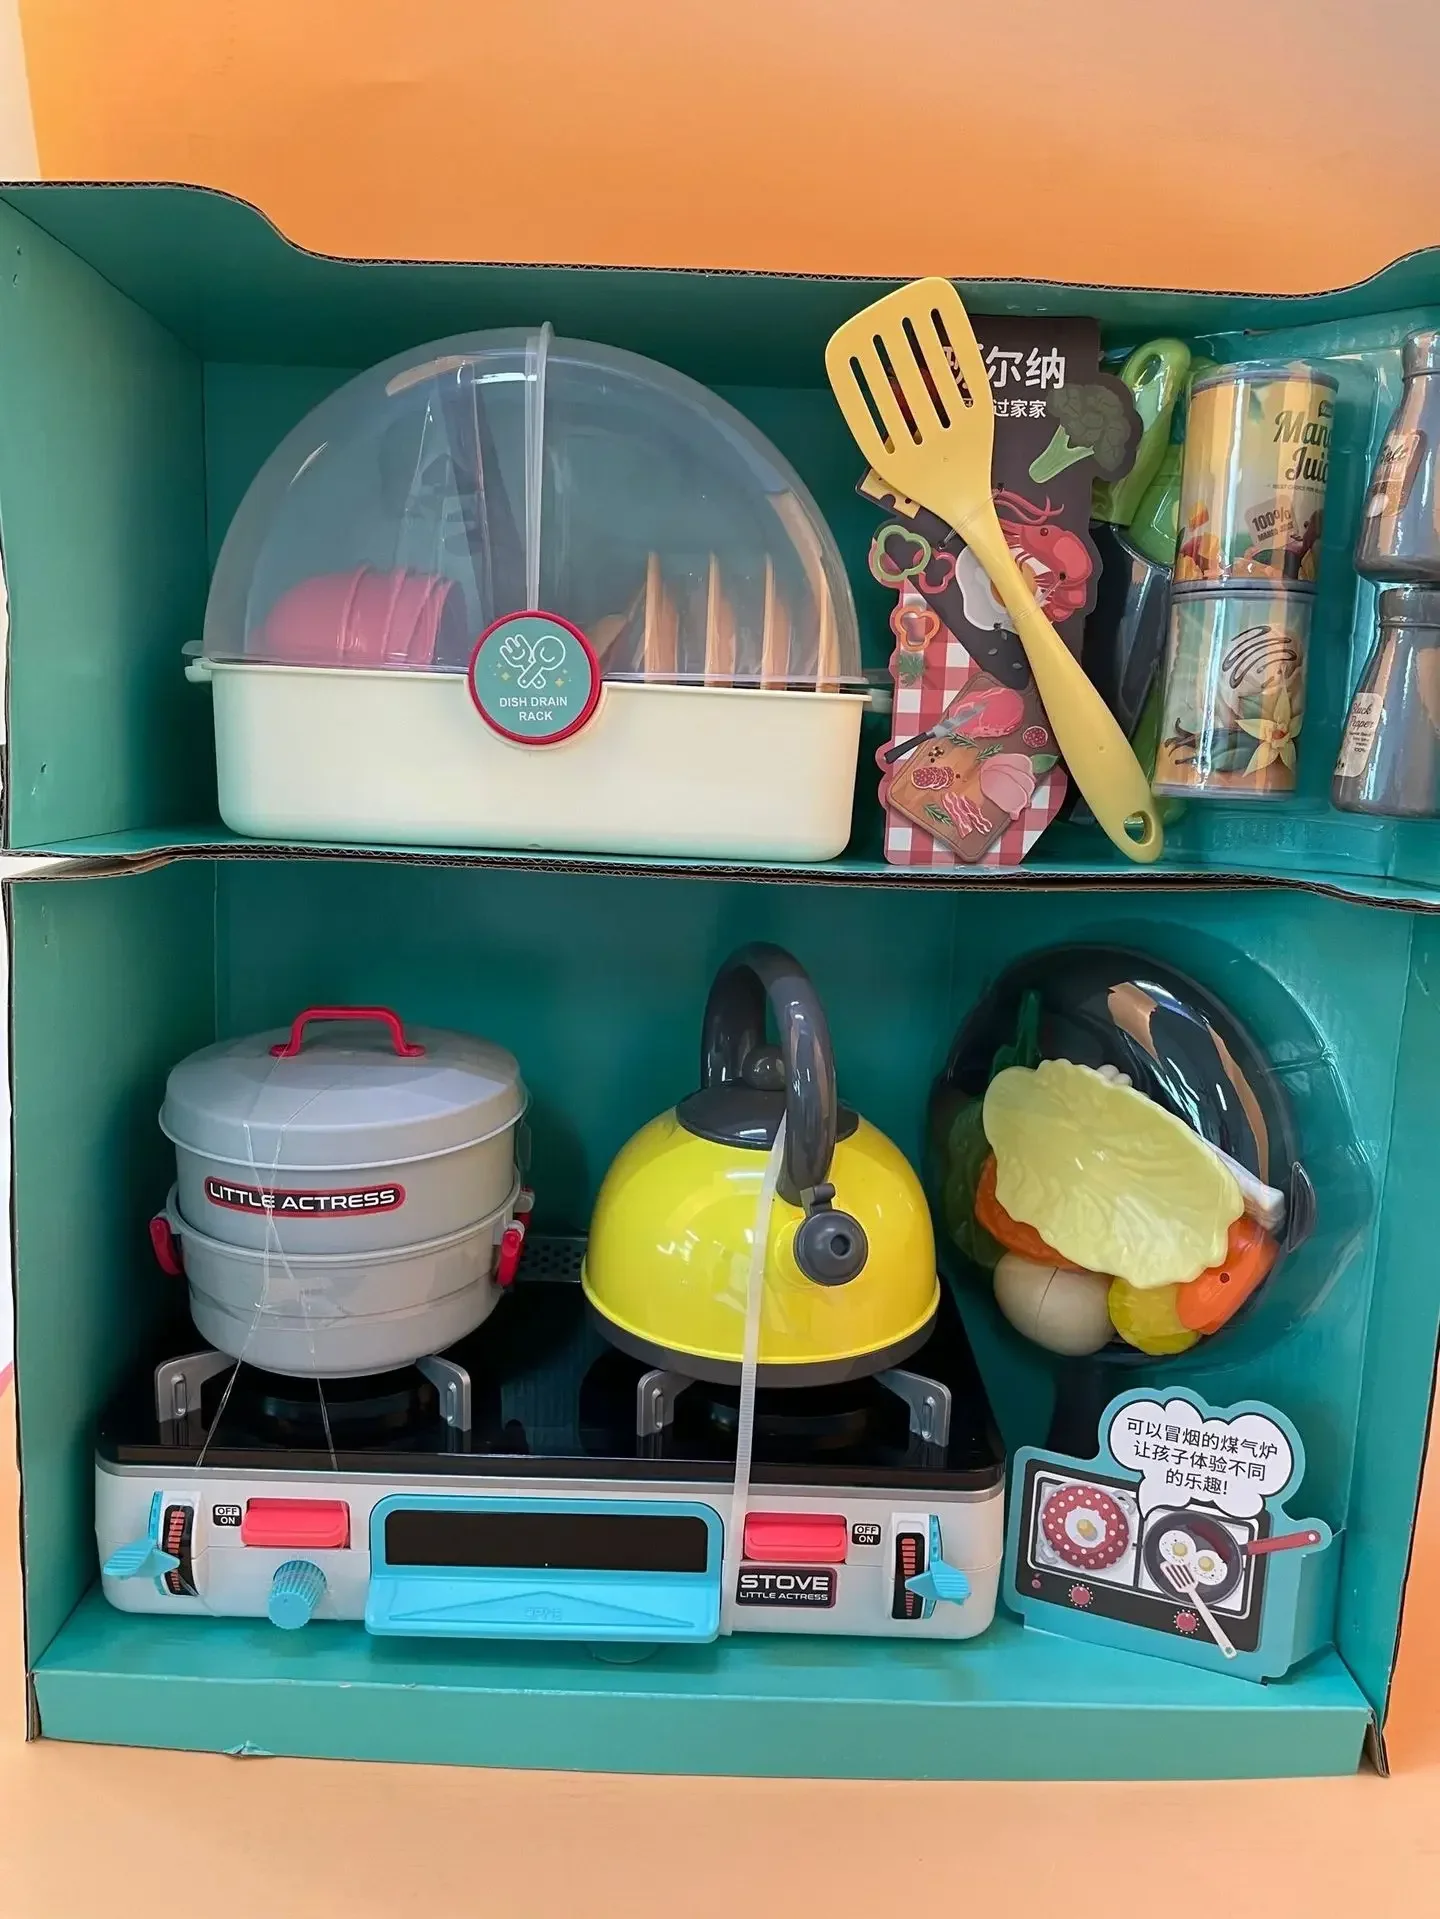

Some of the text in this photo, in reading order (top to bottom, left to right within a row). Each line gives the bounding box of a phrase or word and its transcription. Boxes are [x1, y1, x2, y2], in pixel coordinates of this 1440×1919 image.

[978, 344, 1066, 389] 尔纳
[1252, 506, 1292, 532] 100%
[500, 696, 568, 707] DISH DRAIN
[519, 711, 553, 721] RACK
[209, 1182, 395, 1210] LITTLE ACTRESS
[1126, 1417, 1278, 1460] 可以冒烟的煤气炉
[1133, 1440, 1266, 1481] 让孩子体验不同
[217, 1507, 238, 1516] OFF
[220, 1516, 236, 1525] ON
[856, 1525, 877, 1534] OFF
[859, 1534, 874, 1543] ON
[740, 1574, 829, 1591] STOVE
[739, 1591, 828, 1600] LITTLE ACTRESS
